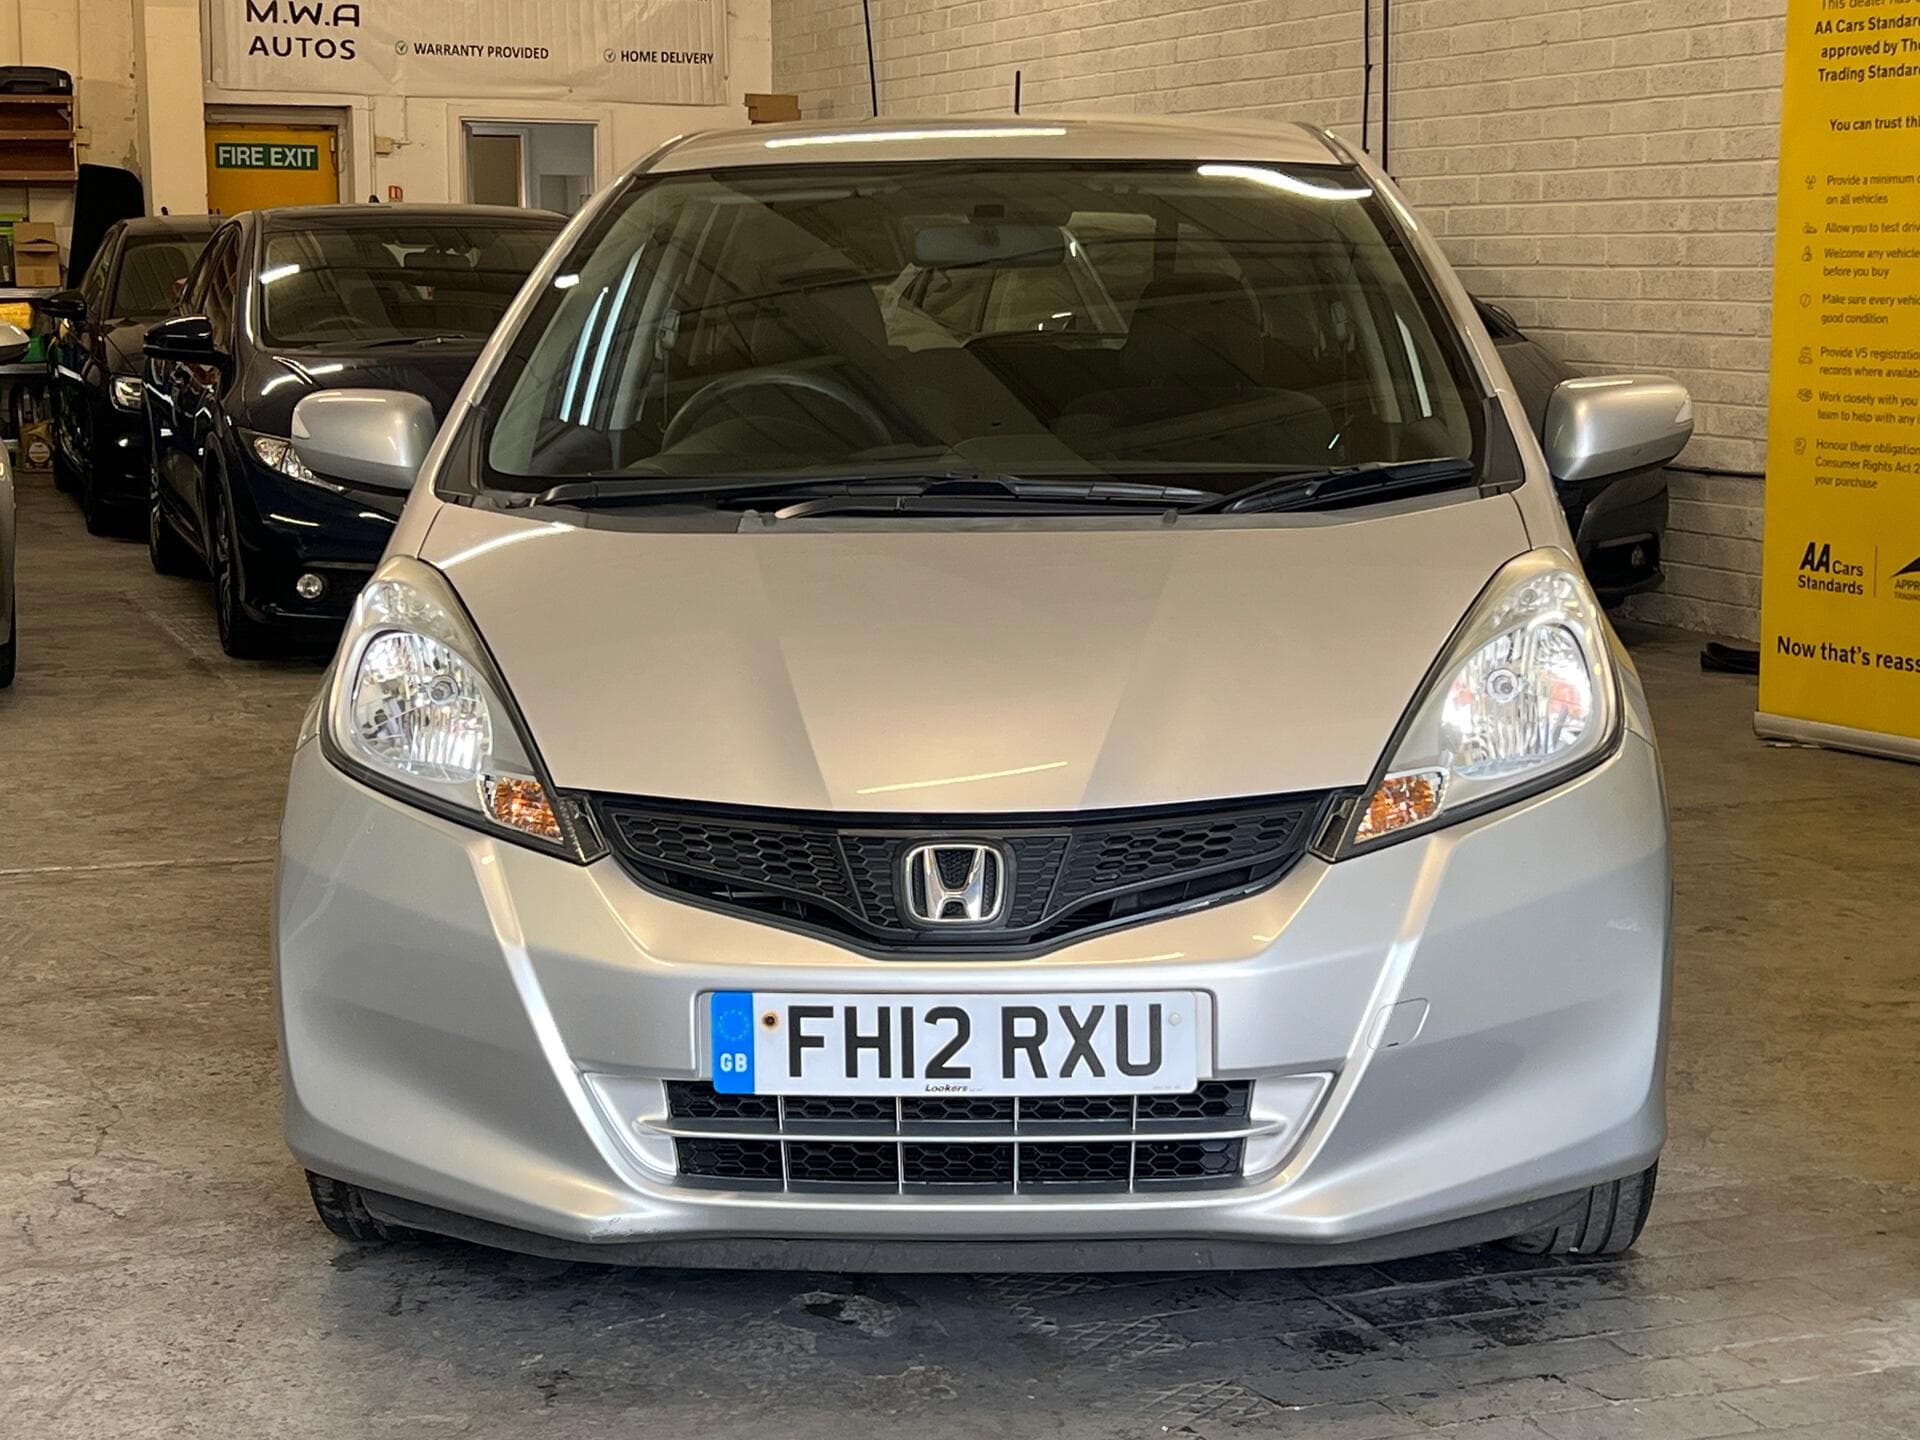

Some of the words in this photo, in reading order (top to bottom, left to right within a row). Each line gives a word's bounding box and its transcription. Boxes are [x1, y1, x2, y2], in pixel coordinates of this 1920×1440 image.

[246, 0, 360, 27] M.W.A
[1815, 21, 1832, 34] AA
[1836, 20, 1864, 33] Cars
[248, 36, 356, 60] AUTOS
[414, 42, 484, 57] WARRANTY
[487, 46, 549, 60] PROVIDED
[1821, 41, 1880, 59] approved
[1884, 41, 1897, 56] by
[621, 50, 657, 63] HOME
[661, 51, 714, 65] DELIVERY
[1818, 68, 1864, 82] Trading
[1868, 64, 1920, 79] Standar
[1830, 119, 1850, 131] You
[1853, 120, 1871, 130] can
[1875, 117, 1901, 129] trust
[219, 146, 264, 166] FIRE
[270, 147, 315, 167] EXIT
[1827, 175, 1860, 186] Provide
[1863, 177, 1867, 185] a
[1870, 175, 1914, 184] minimum
[1826, 196, 1837, 204] on
[1840, 195, 1850, 204] all
[1852, 194, 1888, 204] vehicles
[1825, 223, 1849, 233] Allow
[1852, 225, 1866, 235] you
[1869, 224, 1879, 232] to
[1881, 223, 1899, 232] test
[1824, 249, 1864, 258] Welcome
[1867, 250, 1884, 260] any
[1824, 266, 1851, 276] before
[1853, 269, 1868, 278] you
[1872, 267, 1889, 279] buy
[1822, 294, 1845, 304] Make
[1848, 297, 1866, 305] sure
[1869, 297, 1895, 307] every
[1821, 313, 1843, 325] good
[1845, 314, 1888, 324] condition
[1820, 346, 1852, 358] Provide
[1855, 348, 1867, 358] V5
[1819, 366, 1852, 375] records
[1854, 367, 1883, 377] where
[1819, 391, 1841, 401] Work
[1844, 393, 1874, 405] closely
[1877, 394, 1898, 405] with
[1900, 397, 1917, 407] you
[1818, 410, 1840, 420] team
[1841, 412, 1850, 421] to
[1852, 412, 1872, 423] help
[1874, 414, 1896, 423] with
[1898, 415, 1915, 426] any
[1816, 439, 1849, 451] Honour
[1850, 441, 1872, 451] their
[1815, 456, 1860, 469] Consumer
[1863, 459, 1892, 472] Rights
[1894, 462, 1911, 472] Act
[1815, 476, 1833, 486] your
[1835, 477, 1878, 488] purchase
[1799, 542, 1830, 573] AA
[1832, 560, 1863, 577] Cars
[1798, 575, 1863, 595] Standards
[1777, 635, 1816, 659] Now
[1821, 642, 1870, 666] that's
[1001, 1004, 1162, 1079] RXU
[720, 1053, 747, 1072] GB
[925, 1084, 968, 1092] Lookers
